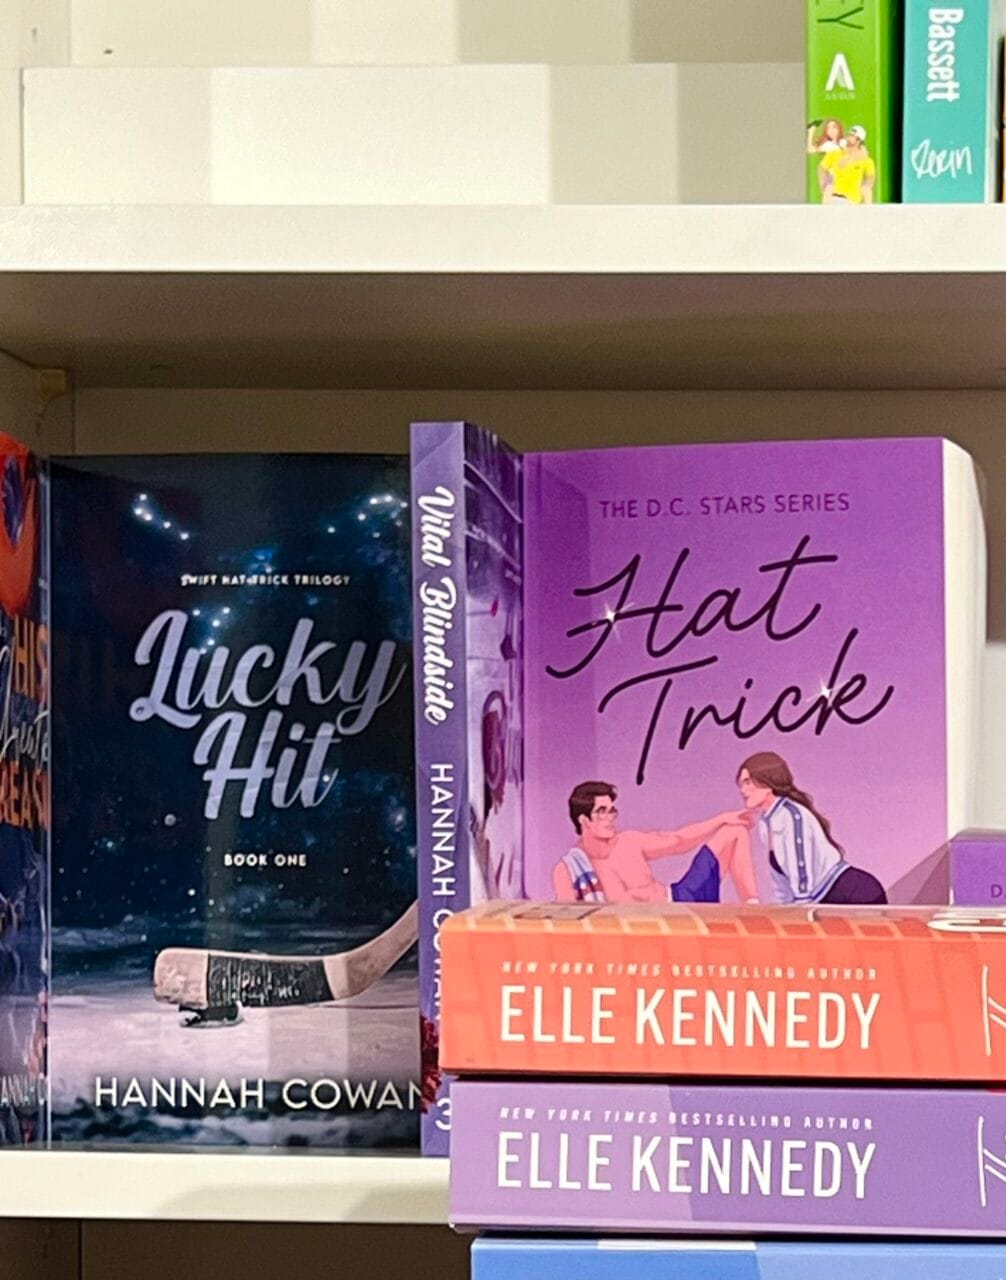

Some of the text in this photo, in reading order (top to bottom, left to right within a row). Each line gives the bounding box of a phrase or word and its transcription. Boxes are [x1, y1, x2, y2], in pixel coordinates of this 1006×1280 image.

[927, 8, 964, 102] Bassett
[601, 493, 850, 518] THE D.C. STARS SERIES
[181, 574, 217, 586] SWIFT
[294, 574, 350, 586] TRILOGY
[417, 486, 457, 726] Vital Blindside
[546, 535, 838, 678] Hat
[130, 610, 407, 735] Lucky
[598, 628, 894, 785] Trick
[193, 711, 341, 819] Hit
[224, 853, 307, 867] BOOK ONE
[430, 764, 456, 896] HANNAH
[501, 985, 880, 1049] ELLE KENNEDY
[95, 1077, 422, 1109] HANNAH COWAN
[500, 1107, 874, 1130] NEW YORK TIMES BESTSELLING AUTHOR
[497, 1131, 876, 1199] ELLE KENNEDY
